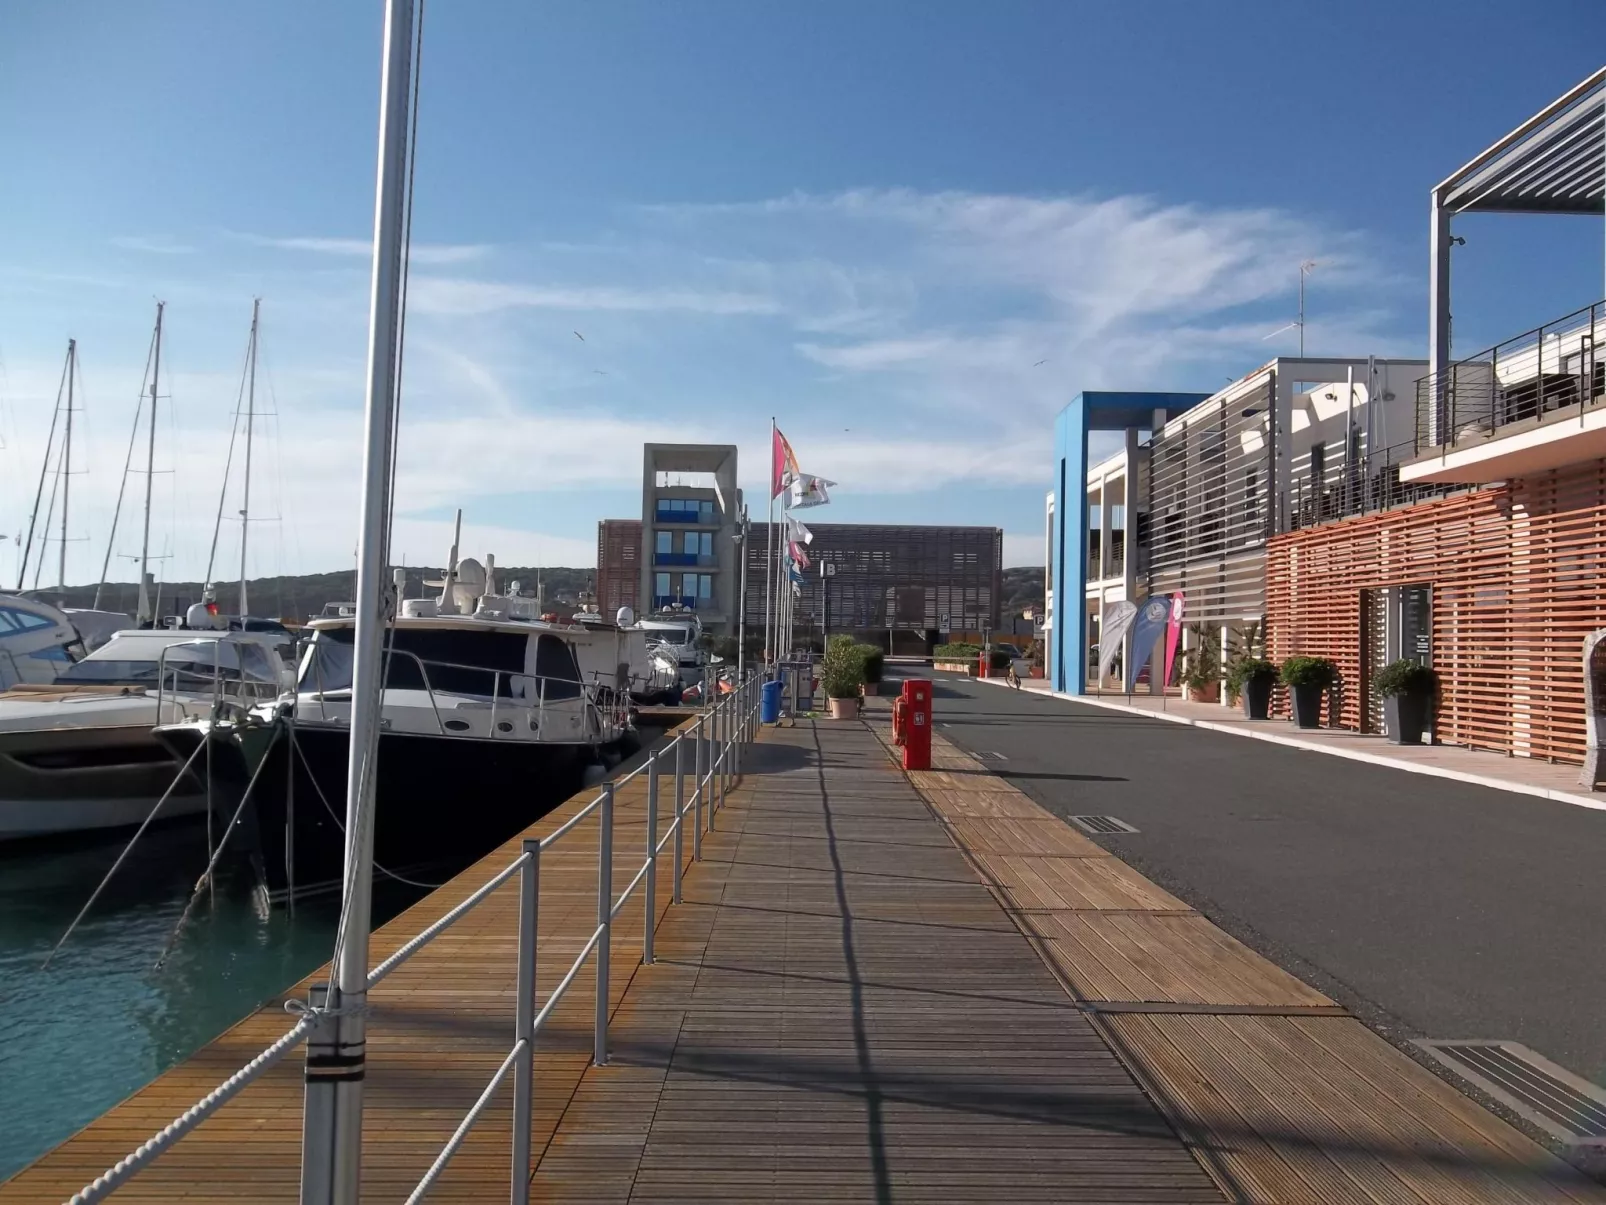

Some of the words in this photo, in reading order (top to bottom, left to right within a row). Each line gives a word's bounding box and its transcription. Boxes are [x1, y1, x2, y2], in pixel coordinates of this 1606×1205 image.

[827, 564, 836, 575] B
[942, 614, 948, 622] P
[1037, 616, 1044, 624] P
